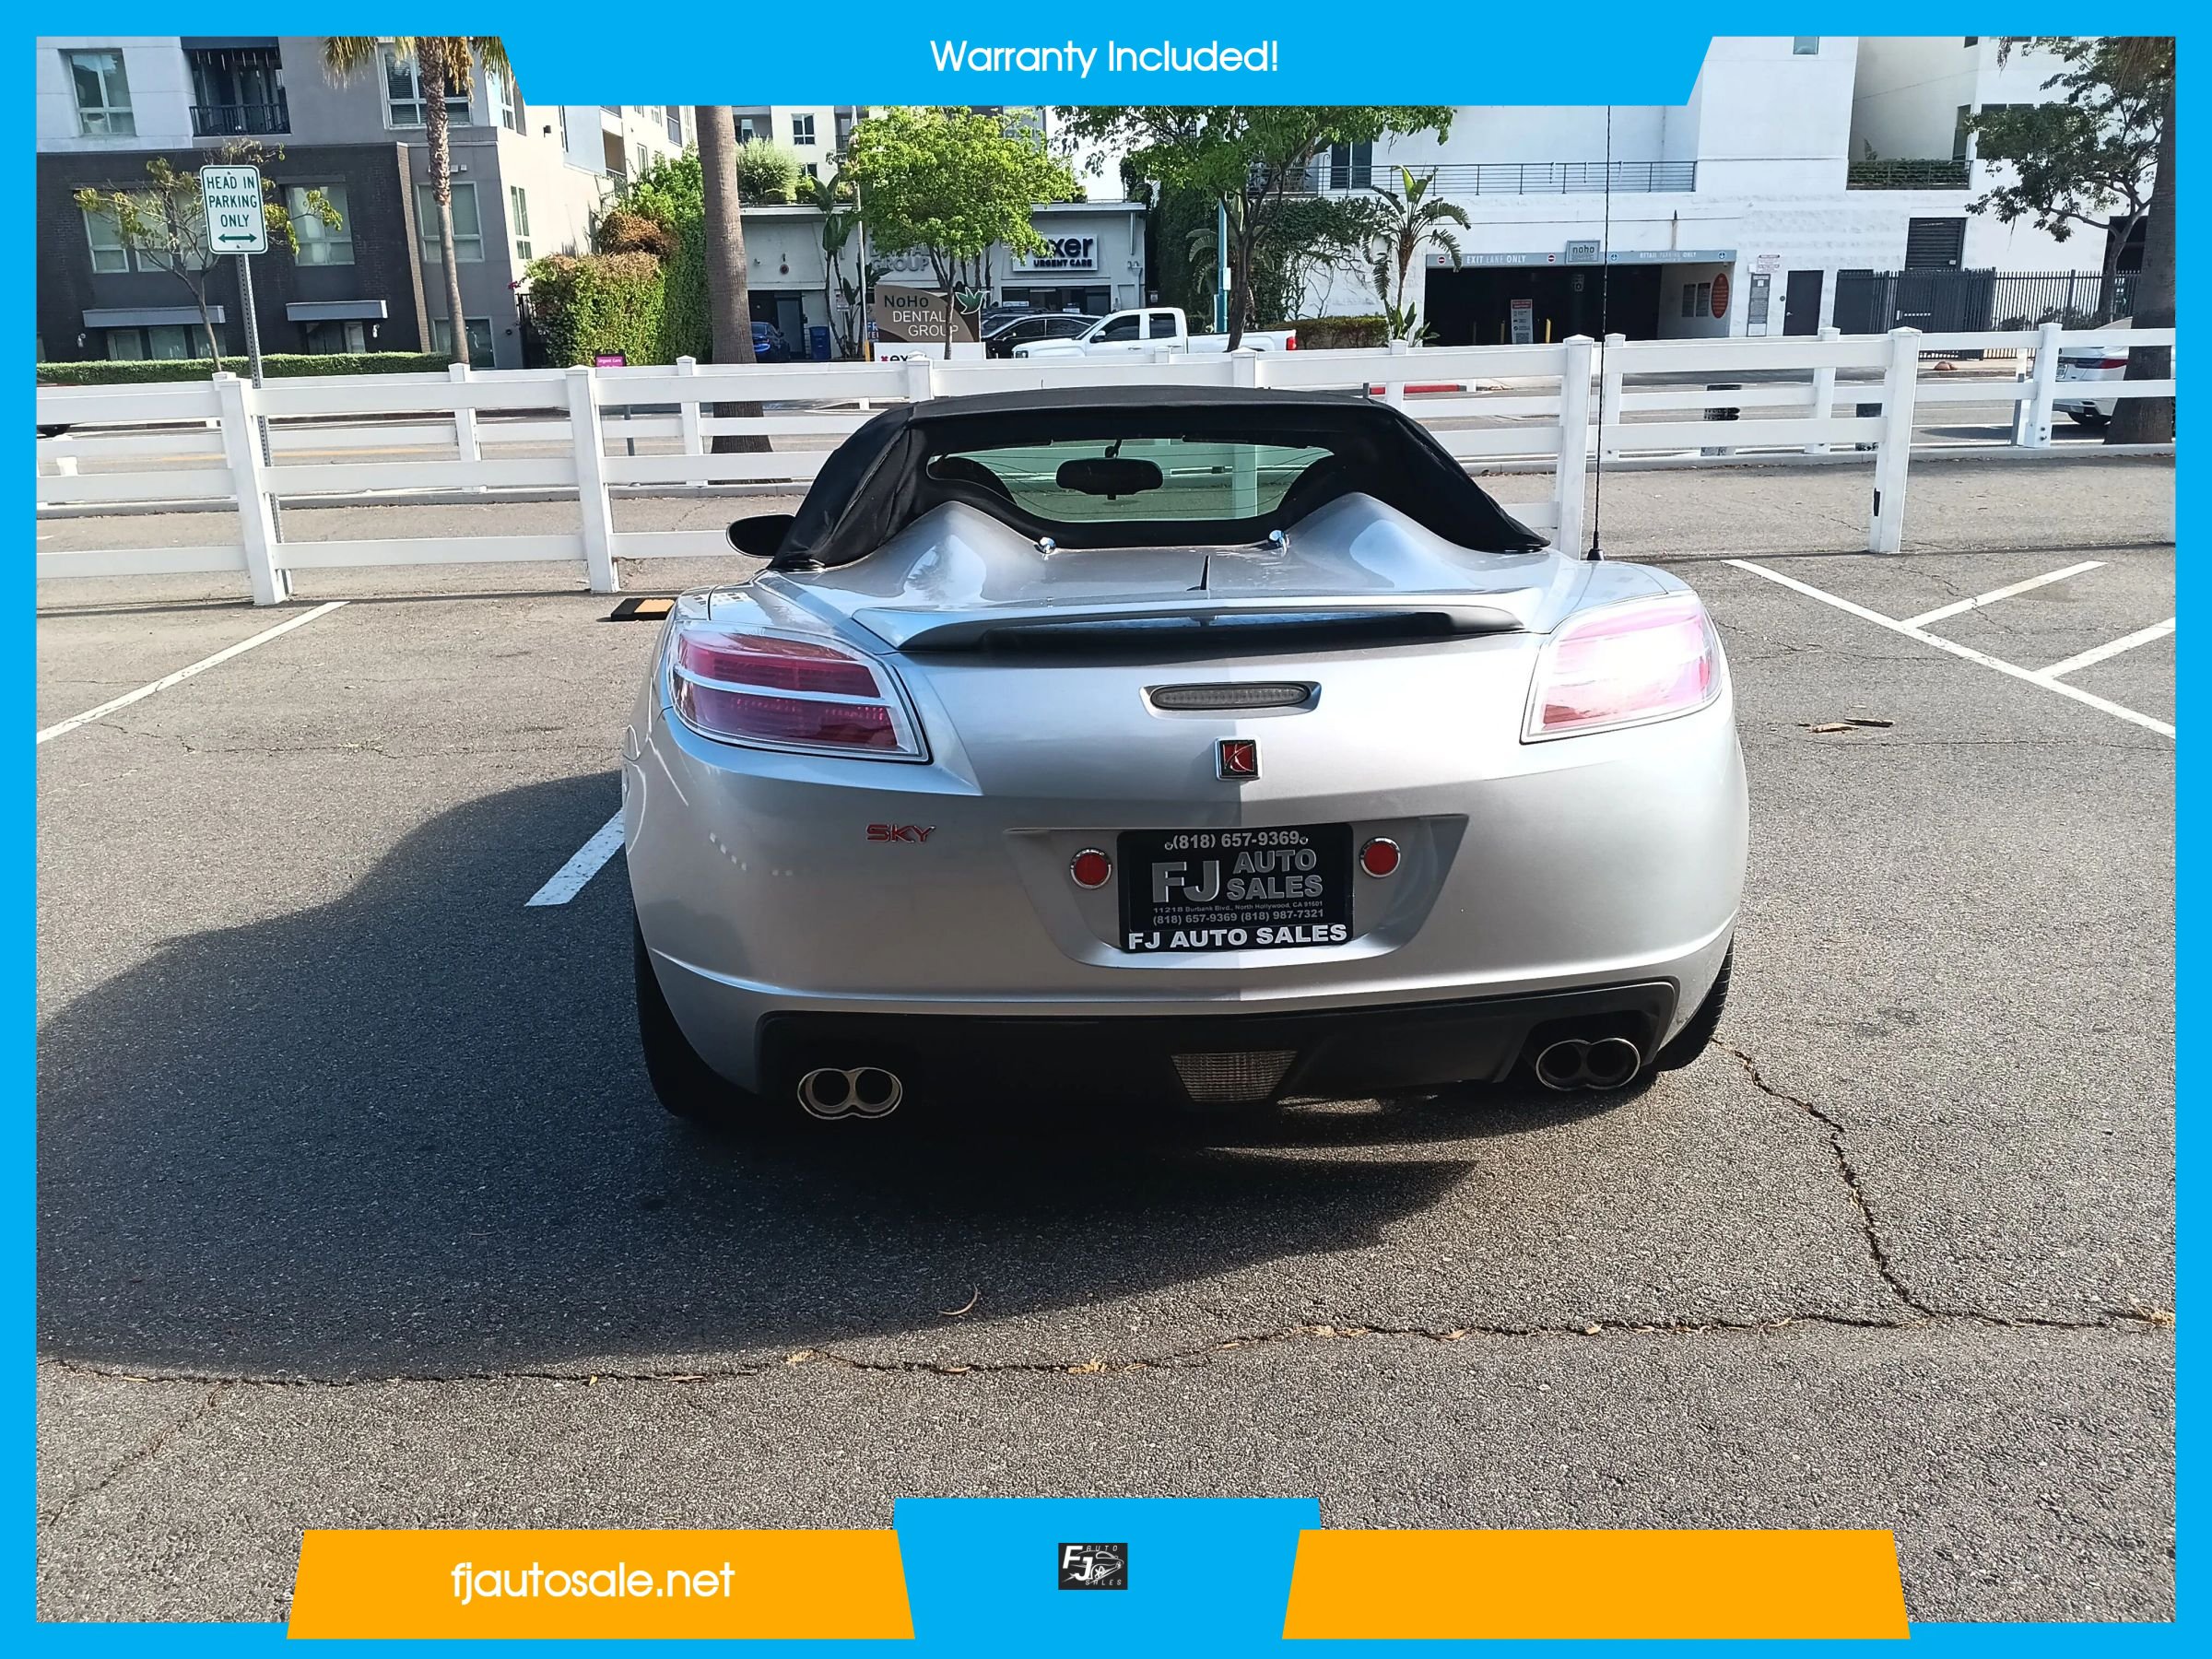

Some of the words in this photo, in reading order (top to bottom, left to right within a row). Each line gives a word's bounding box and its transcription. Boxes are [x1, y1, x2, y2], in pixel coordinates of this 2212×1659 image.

[206, 176, 237, 189] HEAD
[243, 176, 255, 189] IN
[208, 194, 257, 207] PARKING
[221, 215, 249, 227] ONLY
[1033, 259, 1067, 267] URGENT
[1069, 259, 1093, 267] CARE
[1466, 255, 1483, 264] EXIT
[1486, 255, 1503, 264] LANE
[1506, 254, 1526, 263] ONLY
[884, 295, 929, 308] NoHo
[893, 311, 947, 323] DENTAL
[865, 823, 936, 843] SKY
[1172, 833, 1217, 850] (818)
[1221, 830, 1300, 848] 657-9369
[1232, 848, 1317, 875] AUTO
[1152, 859, 1221, 903] FJ
[1226, 875, 1324, 900] SALES
[1153, 914, 1182, 925] (818)
[1185, 912, 1238, 924] 657-9369
[1241, 912, 1270, 922] (818)
[1273, 909, 1324, 920] 987-7321
[1128, 931, 1161, 950] FJ
[1170, 928, 1248, 947] AUTO
[1256, 924, 1347, 945] SALES
